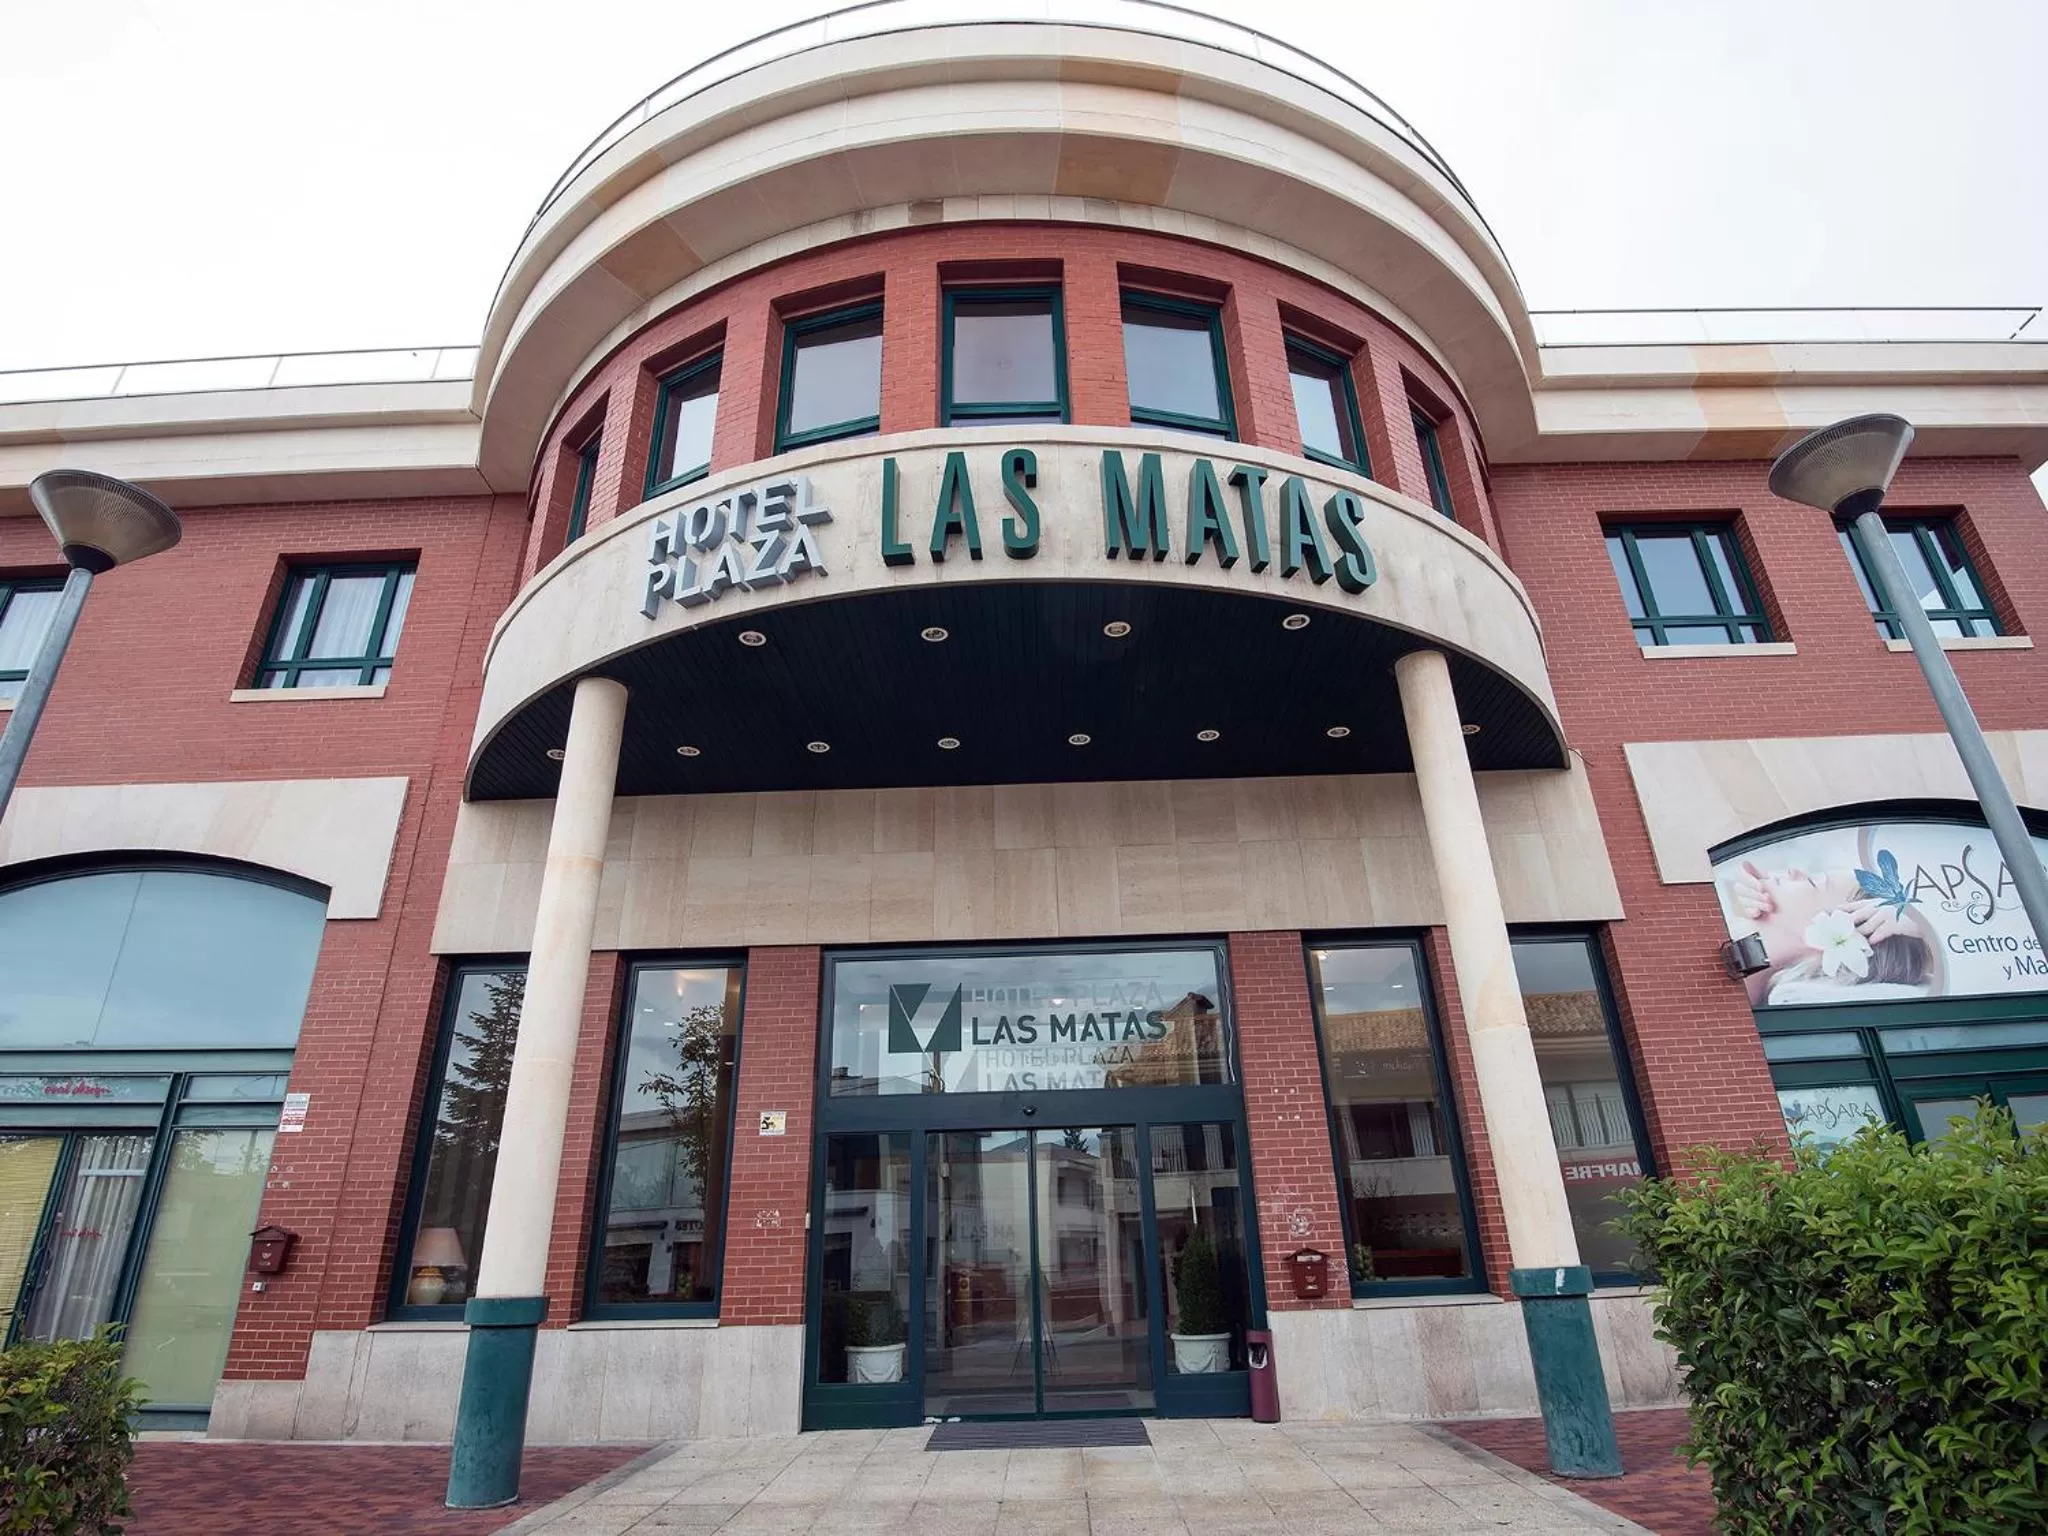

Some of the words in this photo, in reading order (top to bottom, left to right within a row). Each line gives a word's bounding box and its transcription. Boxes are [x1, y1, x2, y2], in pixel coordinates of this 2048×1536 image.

[648, 476, 833, 565] HOTEL
[881, 448, 1040, 566] LAS
[1099, 449, 1377, 595] MATAS
[640, 523, 828, 620] PLAZA
[1912, 844, 2017, 925] APSA
[1947, 933, 2018, 954] Centro
[2003, 963, 2012, 980] y
[1073, 982, 1164, 1007] PLAZA
[971, 1015, 1037, 1045] LAS
[1050, 1010, 1167, 1043] MATAS
[1065, 1045, 1134, 1066] PLAZA
[1805, 1098, 1878, 1129] APSARA
